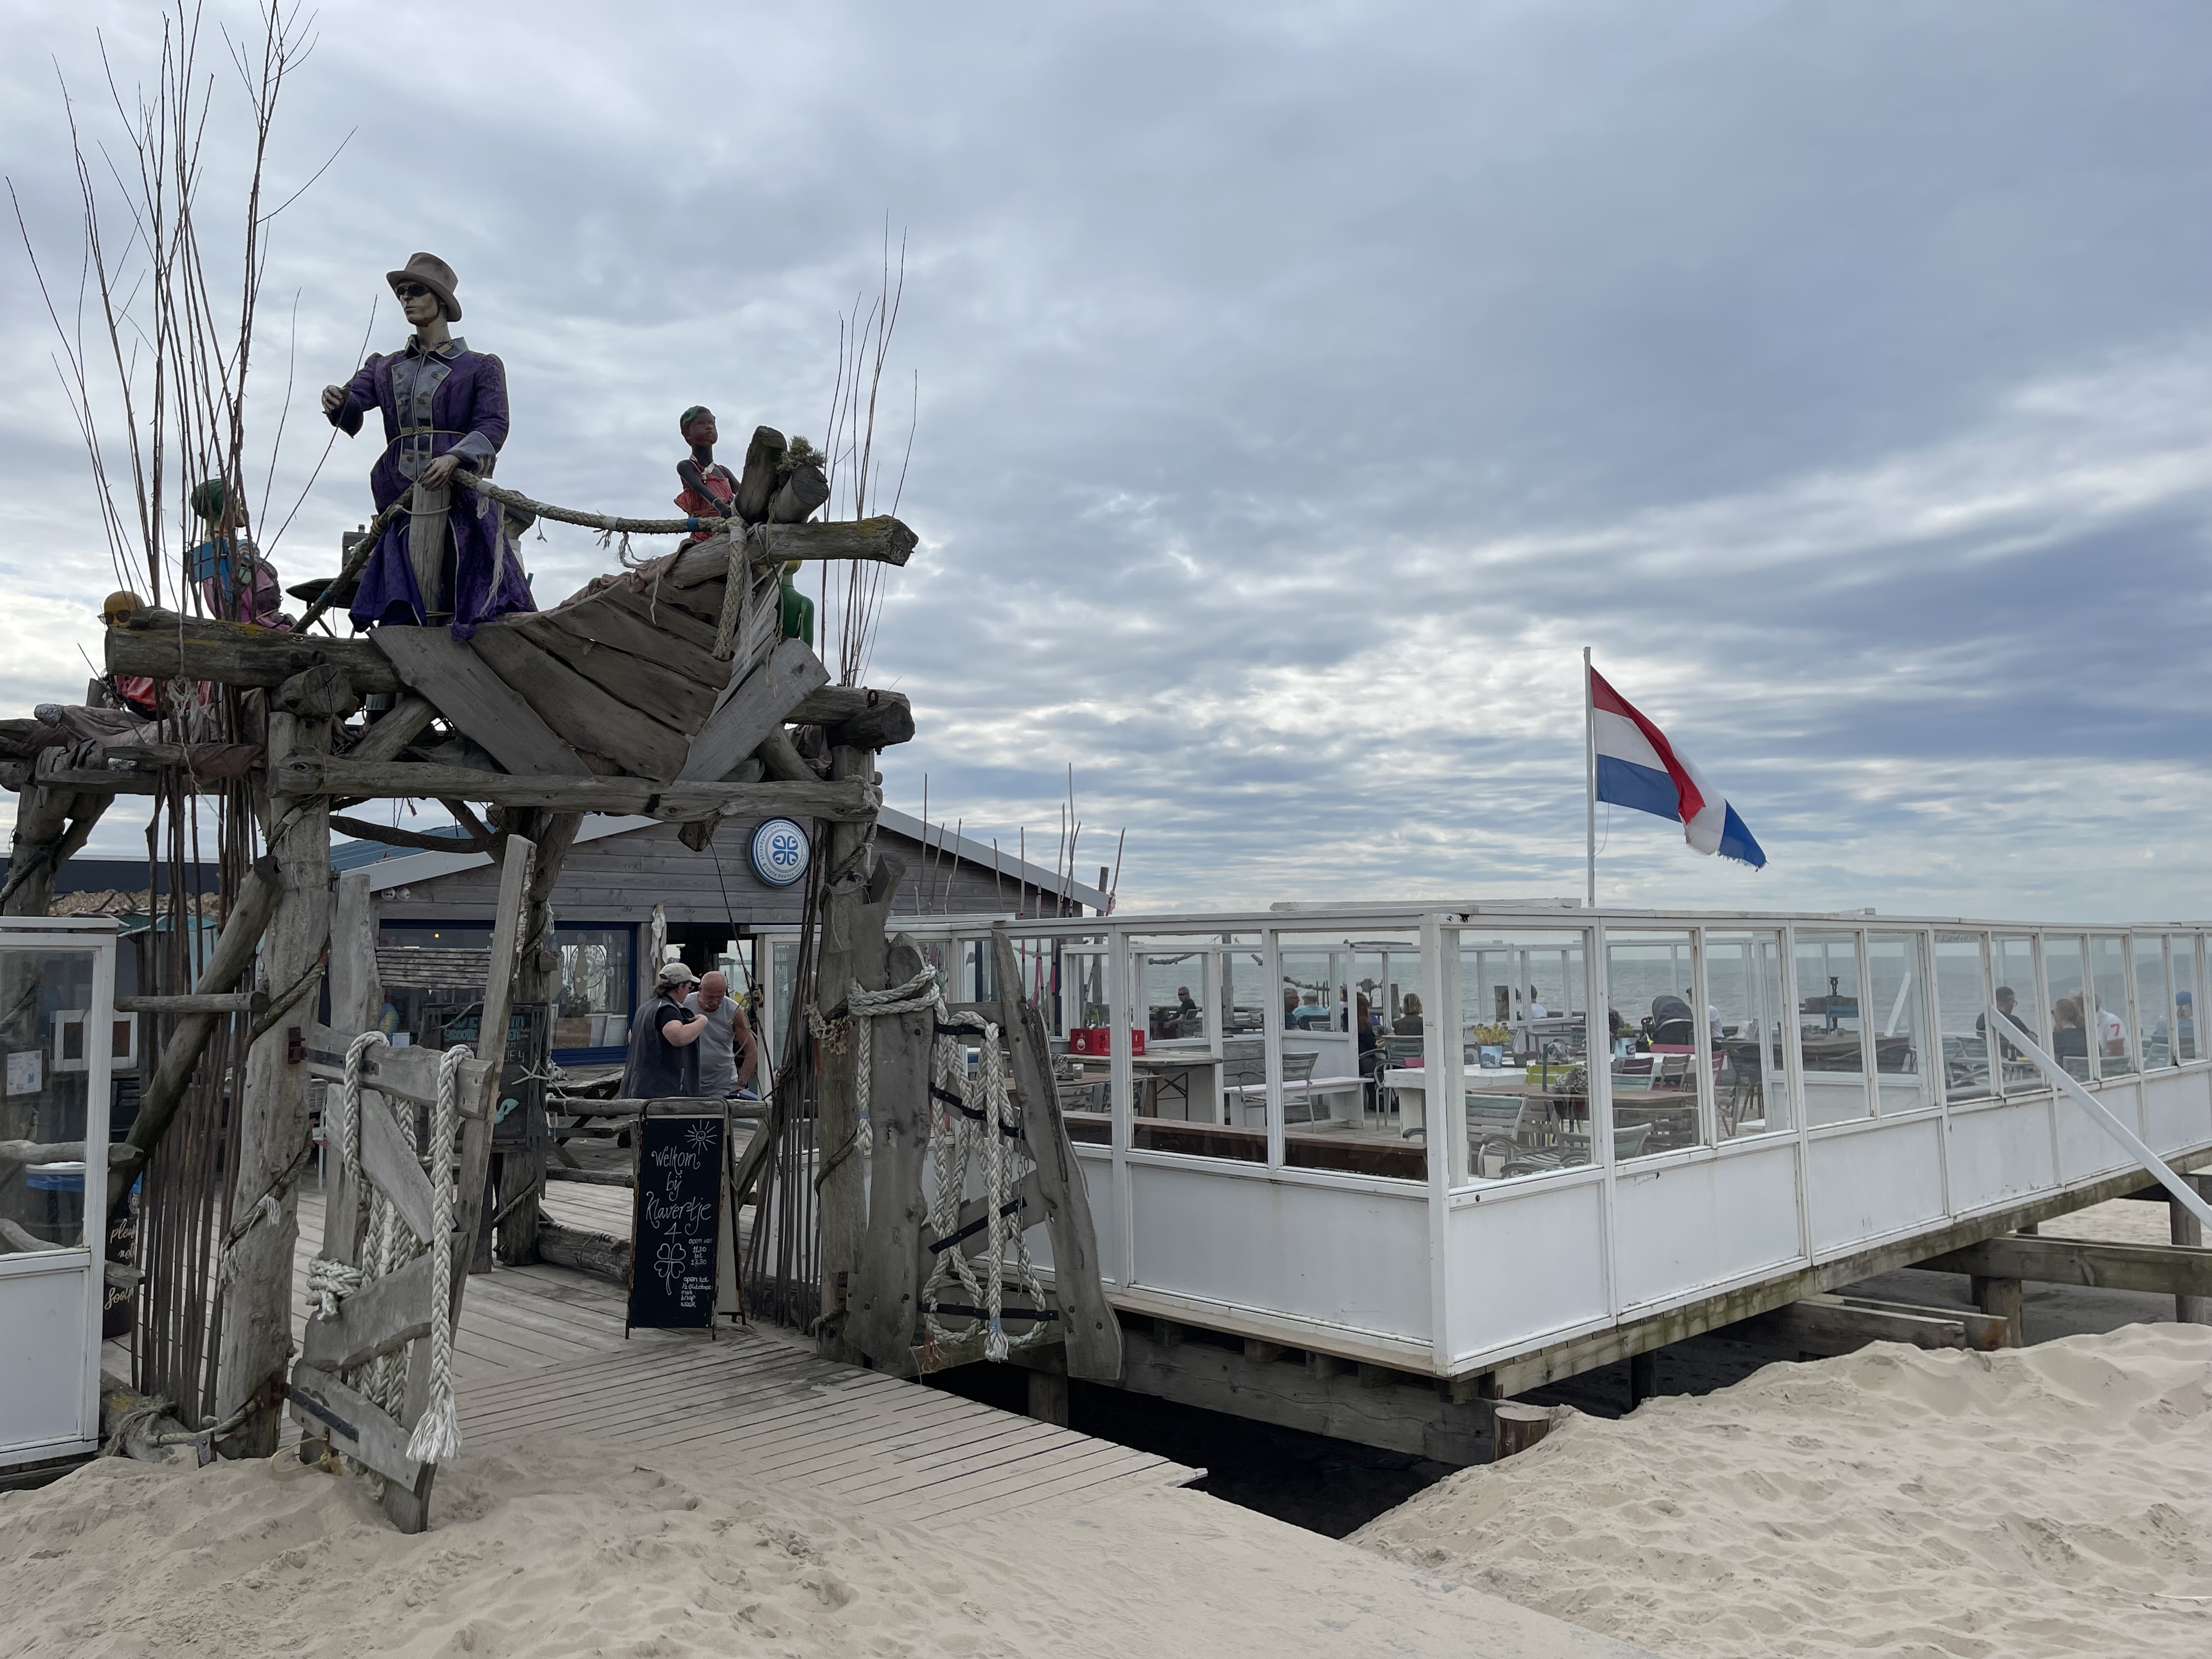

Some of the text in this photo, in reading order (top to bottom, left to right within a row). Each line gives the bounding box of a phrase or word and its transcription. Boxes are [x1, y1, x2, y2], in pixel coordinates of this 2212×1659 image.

[2111, 1023, 2120, 1037] 7
[518, 1050, 524, 1063] 4
[651, 1146, 701, 1175] Welkom
[646, 1191, 712, 1235] Klavertje
[664, 1222, 682, 1244] 4
